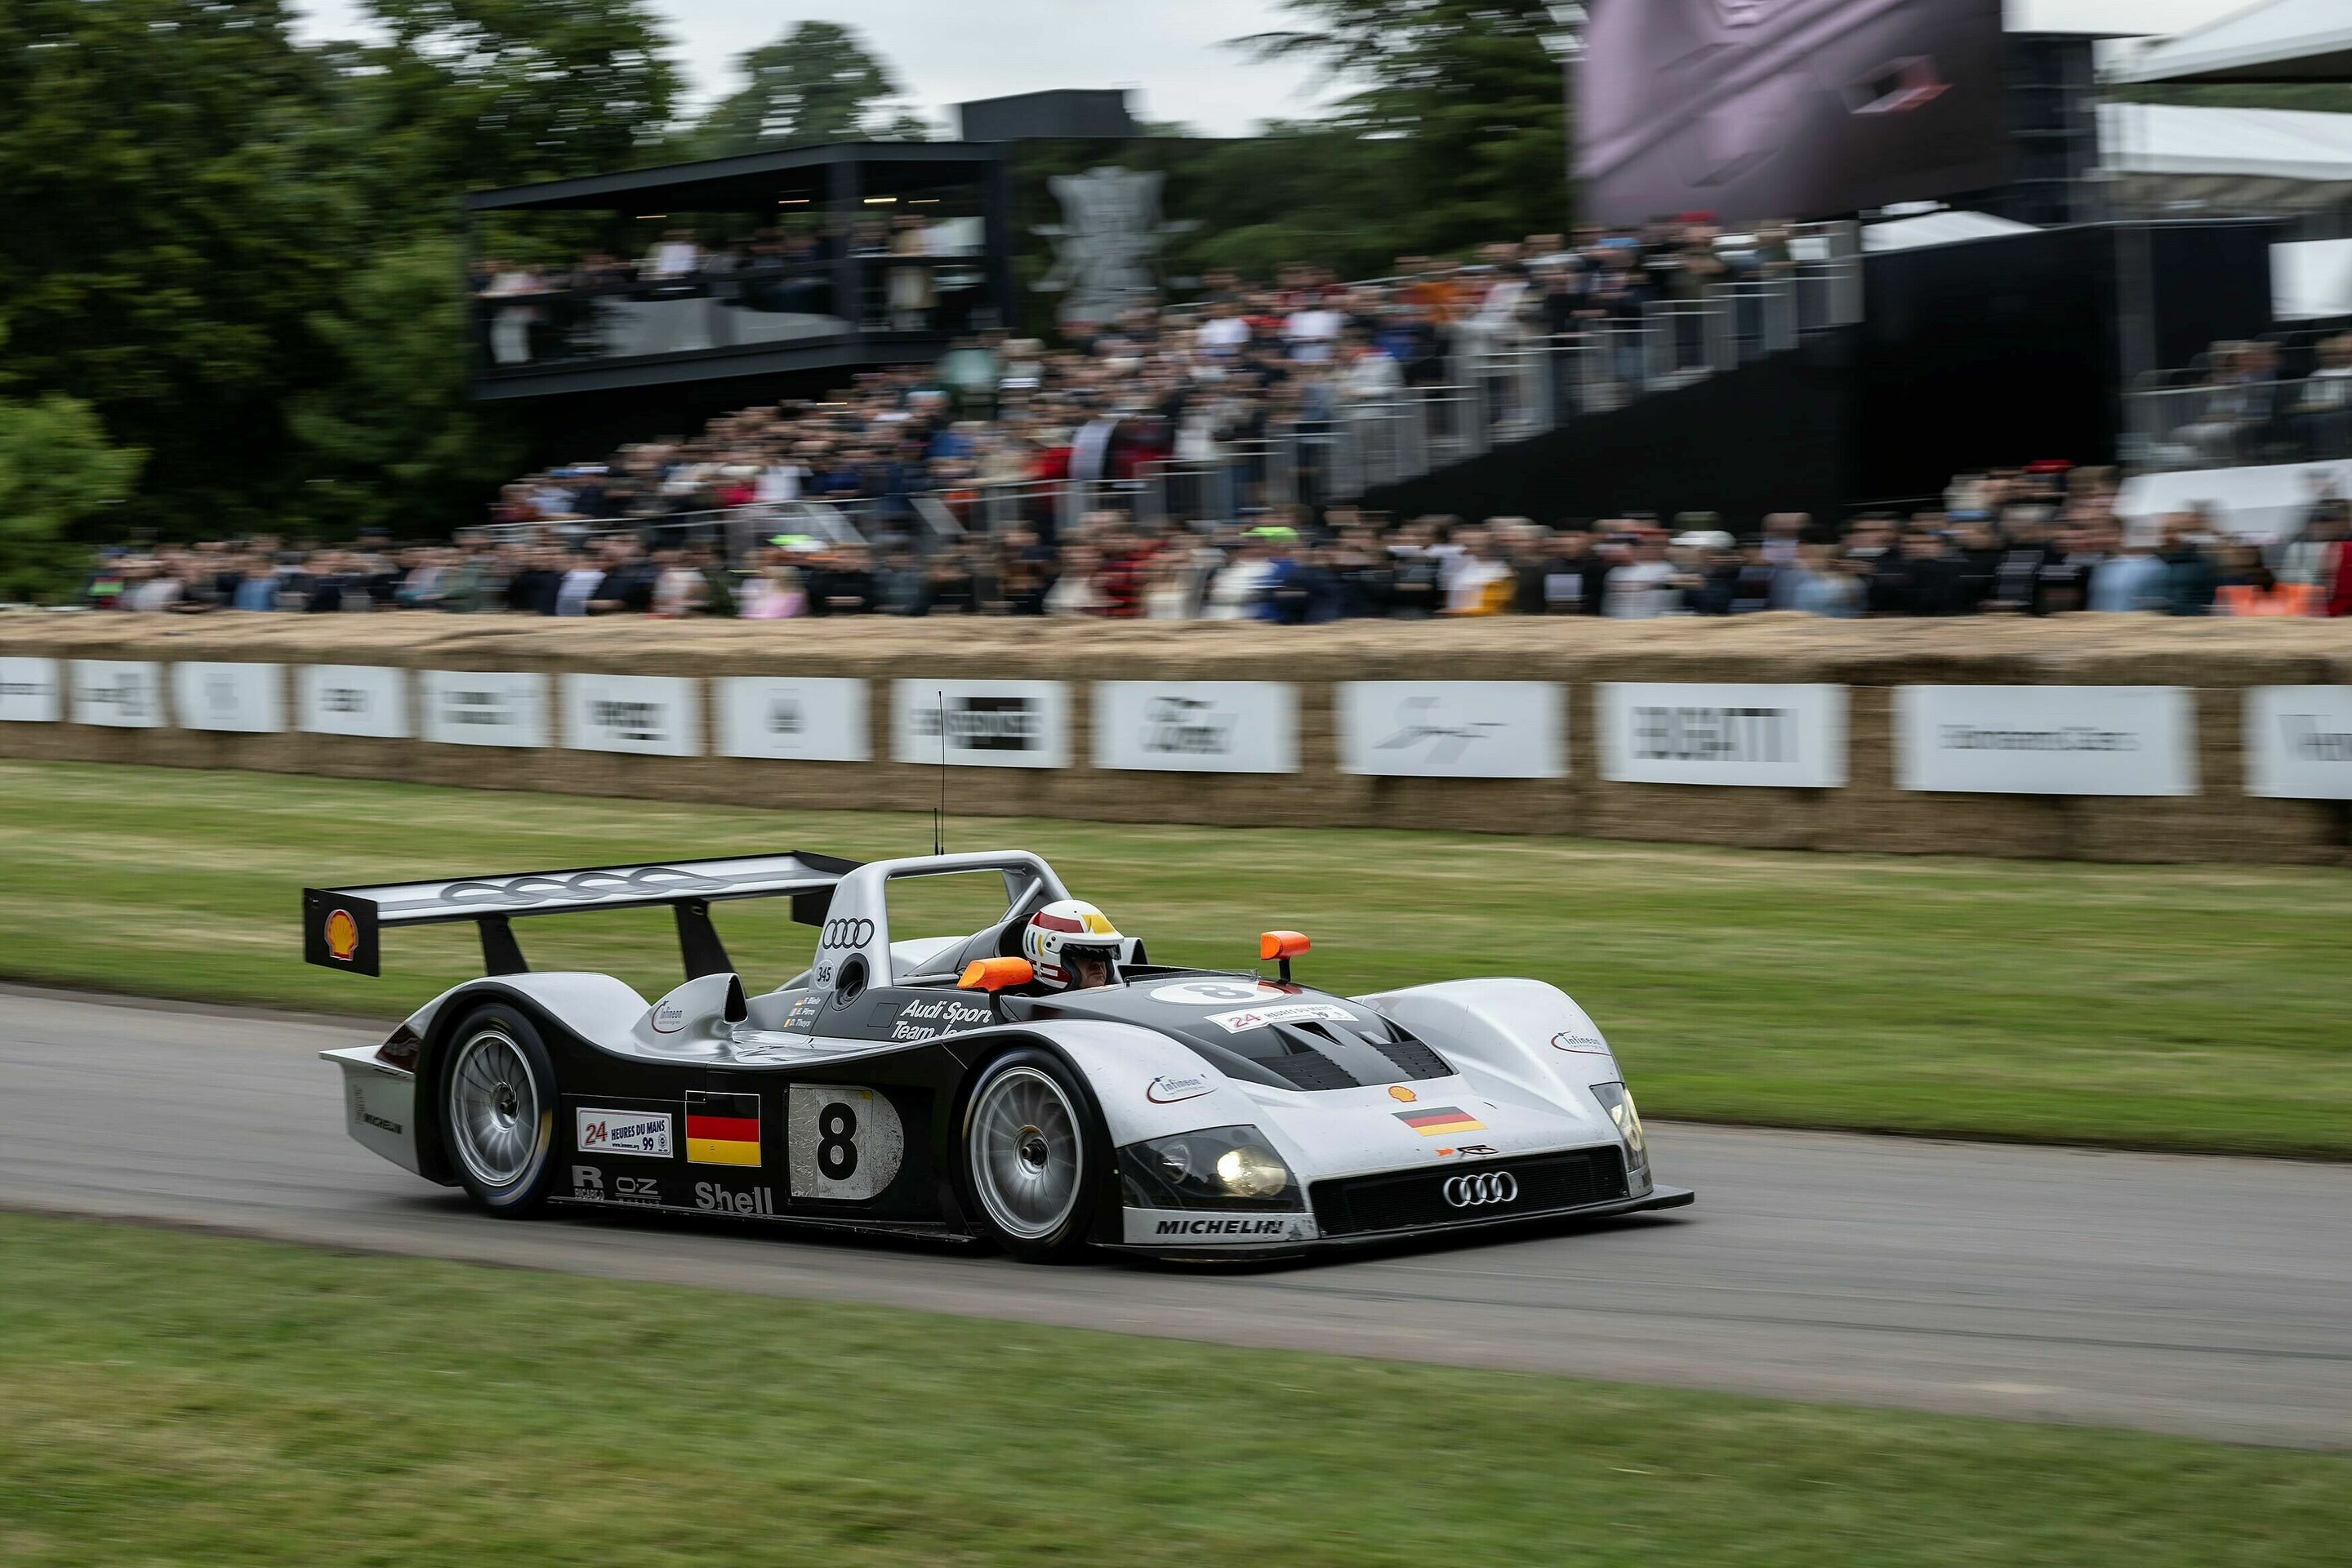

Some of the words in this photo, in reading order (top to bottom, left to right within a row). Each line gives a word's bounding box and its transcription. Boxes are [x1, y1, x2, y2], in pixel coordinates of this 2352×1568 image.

[817, 966, 831, 982] 345
[1183, 984, 1254, 1000] 8
[900, 999, 947, 1019] Audi
[942, 1001, 993, 1024] Sport
[1229, 1013, 1261, 1029] 24
[891, 1021, 935, 1040] Team
[584, 1121, 608, 1147] 24
[611, 1125, 635, 1141] HEURES
[636, 1123, 645, 1136] DU
[646, 1120, 665, 1134] MANS
[817, 1102, 858, 1181] 8
[643, 1137, 654, 1151] 99
[572, 1165, 604, 1188] R
[695, 1182, 773, 1214] Shell
[1156, 1220, 1285, 1235] MICHELIN
